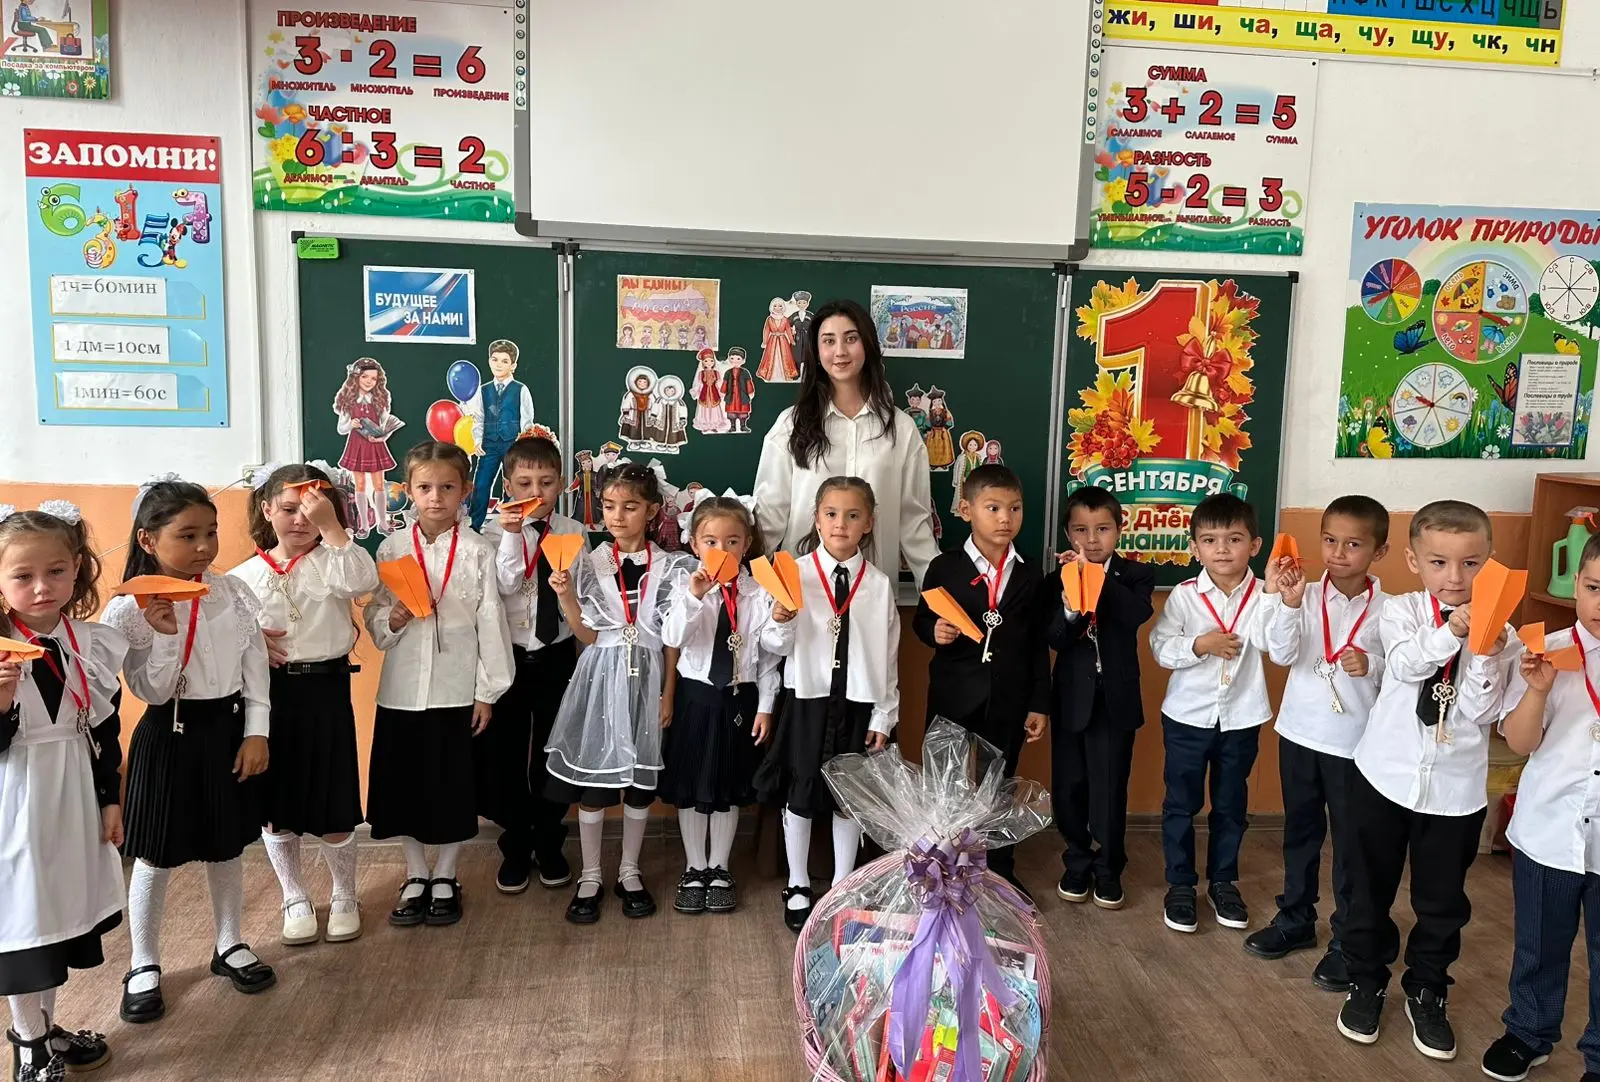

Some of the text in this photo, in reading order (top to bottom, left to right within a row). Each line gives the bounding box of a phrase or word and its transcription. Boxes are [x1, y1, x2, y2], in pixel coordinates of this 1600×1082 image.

[277, 11, 416, 32] ПРОИЗВЕДЕНИЕ
[1107, 9, 1556, 54] жи, ши, ча, ща, чу, щу, чк, чн
[45, 64, 94, 72] компьютером
[294, 36, 323, 75] 3
[369, 39, 397, 78] 2
[456, 46, 486, 84] 6
[1147, 65, 1208, 83] СУММА
[271, 80, 509, 101] МНОЖИТЕЛЬ МНОЖИТЕЛЬ ПРОИЗВЕДЕНИЕ
[308, 105, 391, 124] ЧАСТНОЕ
[1123, 87, 1148, 123] 3
[1199, 90, 1223, 125] 2
[1272, 95, 1297, 130] 5
[1110, 128, 1299, 145] СЛАГАЕМОЕ СЛАГАЕМОЕ СУММА
[28, 142, 217, 171] ЗАПОМНИ!
[295, 129, 325, 167] 6
[369, 132, 398, 169] 3
[458, 136, 486, 174] 2
[1133, 150, 1212, 167] РАЗНОСТЬ
[284, 173, 496, 191] ДЕЛИМОЕ ДЕЛИТЕЛЬ ЧАСТНОЕ
[1124, 172, 1149, 207] 5
[1185, 174, 1210, 209] 2
[1259, 177, 1283, 212] 3
[1097, 213, 1291, 227] УМЕНЬШАЕМОЕ ВЫЧИТАЕМОЕ РАЗНОСТЬ
[1364, 215, 1600, 245] УГОЛОК ПРИРОДЫ
[375, 293, 437, 309] БУДУЩЕЕ
[404, 311, 463, 326] ЗА НАМИ!
[1093, 470, 1223, 496] СЕНТЯБРЯ
